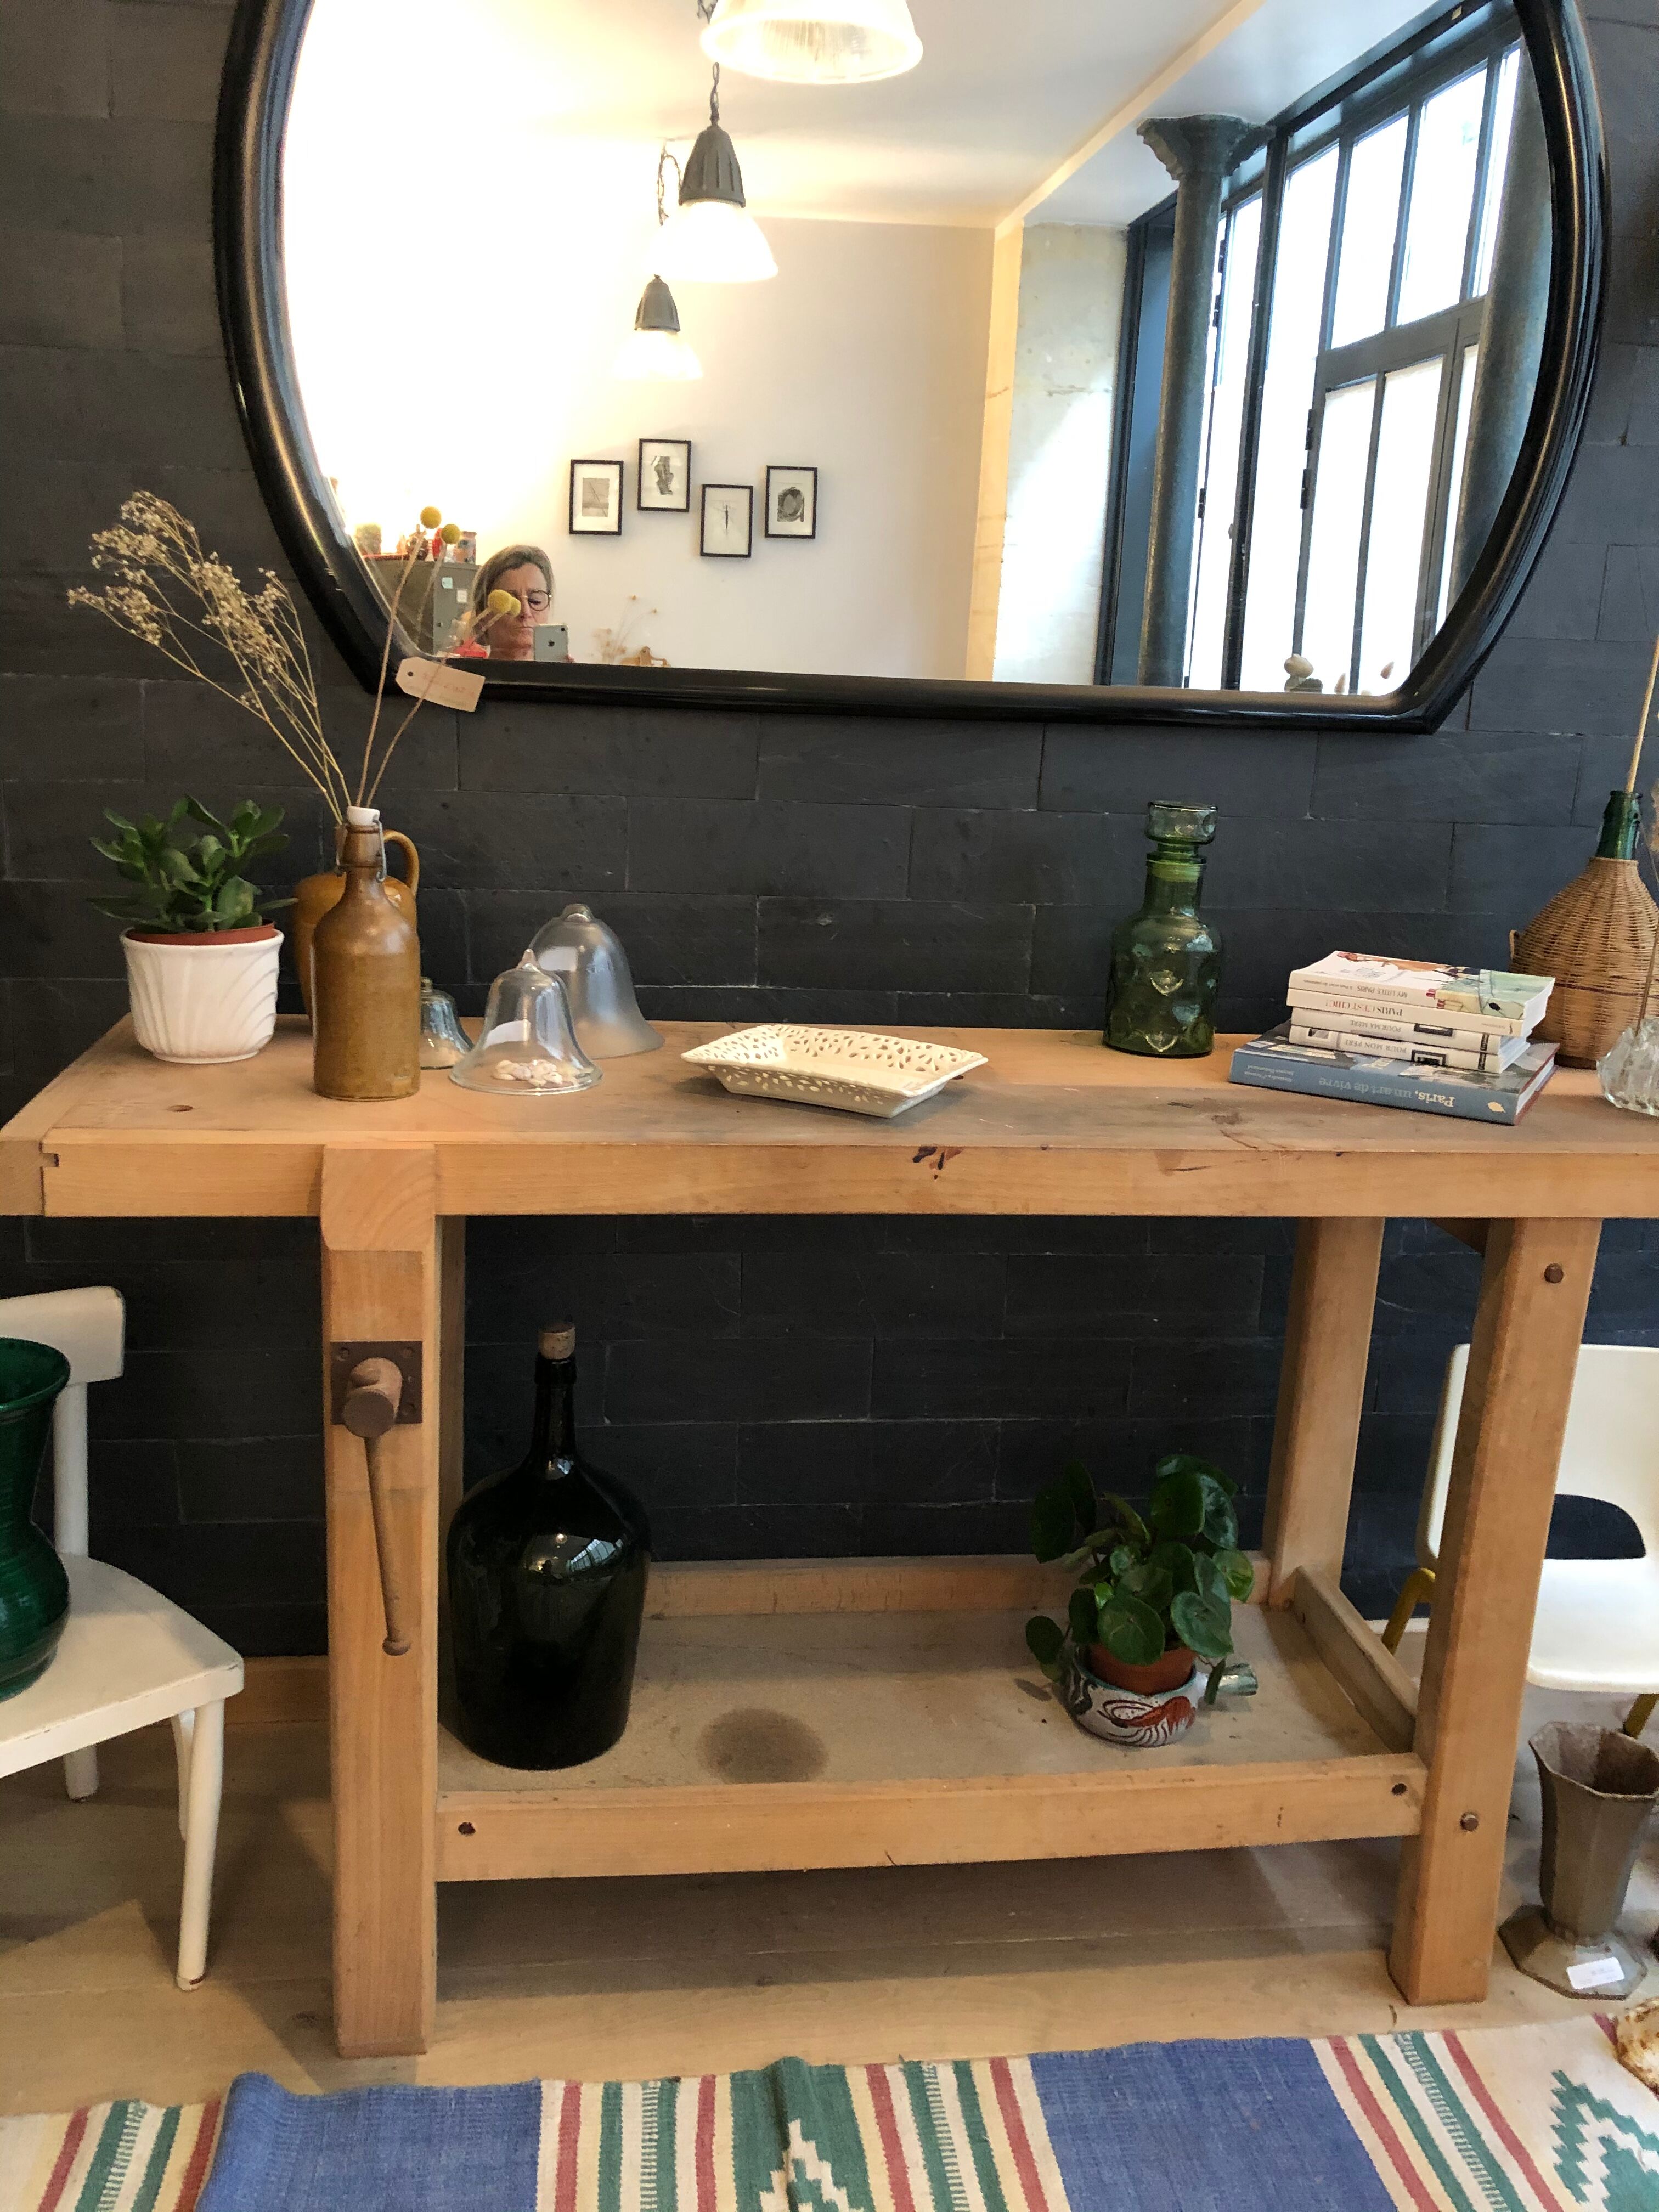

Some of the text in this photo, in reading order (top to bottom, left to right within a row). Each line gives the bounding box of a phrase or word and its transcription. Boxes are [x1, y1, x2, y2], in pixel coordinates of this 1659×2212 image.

[1377, 988, 1395, 996] LITTLE
[1377, 1007, 1403, 1017] PARIS
[1318, 1077, 1456, 1107] Paris, un art de vivre
